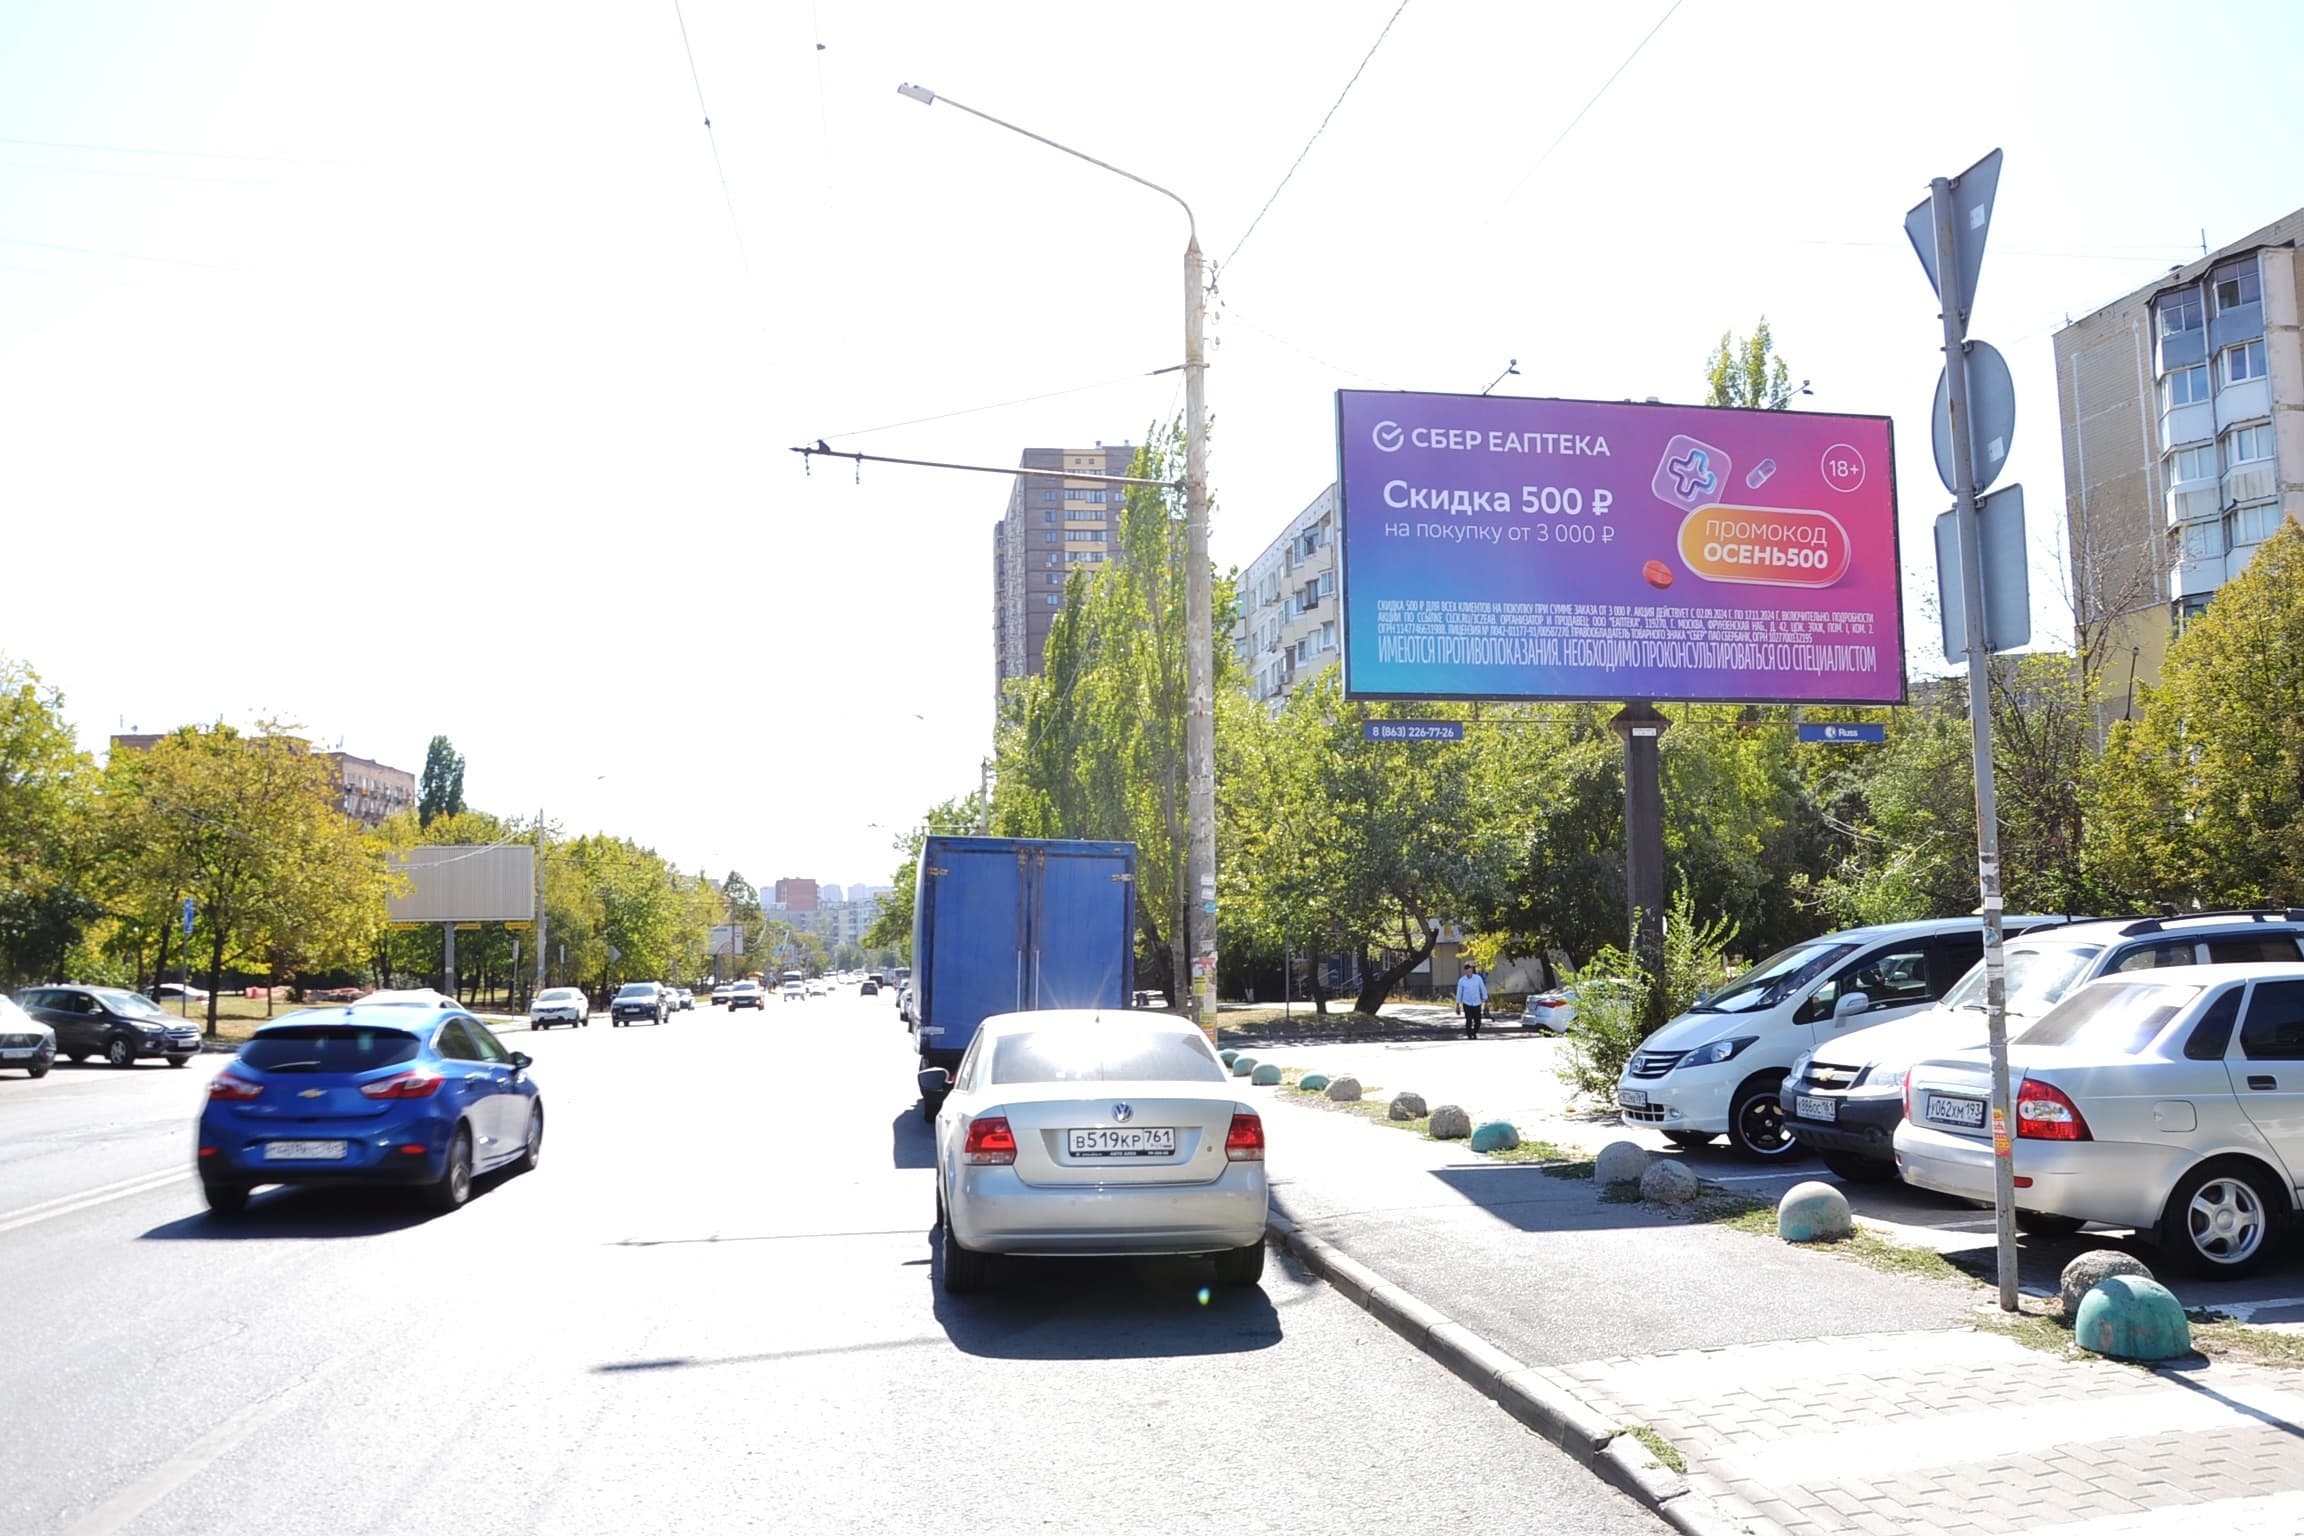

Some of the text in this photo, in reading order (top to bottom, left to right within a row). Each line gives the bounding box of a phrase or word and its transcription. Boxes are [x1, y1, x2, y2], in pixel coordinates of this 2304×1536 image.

[1411, 427, 1611, 457] СБЕР ЕАПТЕКА
[1829, 459, 1861, 478] 18+
[1383, 479, 1512, 516] Скидка
[1521, 485, 1584, 516] 500
[1384, 522, 1410, 538] на
[1416, 522, 1503, 545] покупку
[1507, 526, 1532, 542] от
[1536, 523, 1549, 542] 3
[1555, 523, 1597, 544] 000
[1704, 519, 1828, 548] промокод
[1703, 542, 1829, 570] ОСЕНЬ500
[1404, 612, 1414, 624] ПО
[1416, 612, 1443, 625] ССЫЛКЕ
[1499, 614, 1544, 627] ОРГАНИЗАТОР
[1546, 615, 1552, 628] И
[1592, 617, 1606, 629] ООО
[1678, 619, 1706, 632] МОСКВА,
[1707, 620, 1750, 633] ФРУНЗЕНСКАЯ
[1440, 601, 1457, 613] ВСЕХ
[1458, 601, 1491, 613] КЛИЕНТОВ
[1492, 602, 1502, 614] НА
[1502, 602, 1534, 615] ПОКУПКУ
[1534, 603, 1549, 615] ПРИ
[1550, 604, 1572, 616] СУММЕ
[1573, 604, 1598, 616] ЗАКАЗА
[1598, 605, 1607, 617] ОТ
[1634, 606, 1655, 618] АКЦИЯ
[1656, 606, 1689, 619] ДЕЙСТВУЕТ
[1734, 608, 1744, 620] ПО
[1831, 611, 1874, 623] ПОДРОБНОСТИ
[1570, 628, 1630, 641] ПРАВООБЛАДАТЕЛЬ
[1630, 629, 1666, 642] ТОВАРНОГО
[1666, 630, 1686, 643] ЗНАКА
[1708, 631, 1722, 643] ПАО
[1752, 632, 1768, 645] ОГРН
[1378, 635, 1877, 677] ИМЕЮТСЯ ПРОТИВОПОКАЗАНИЯ. НЕОБХОДИМО ПРОКОНСУЛЬТИРОВАТЬСЯ СО СПЕЦИАЛИСТОМ
[1372, 725, 1455, 738] 8 (863) 226-77-26
[1144, 1130, 1171, 1144] 761
